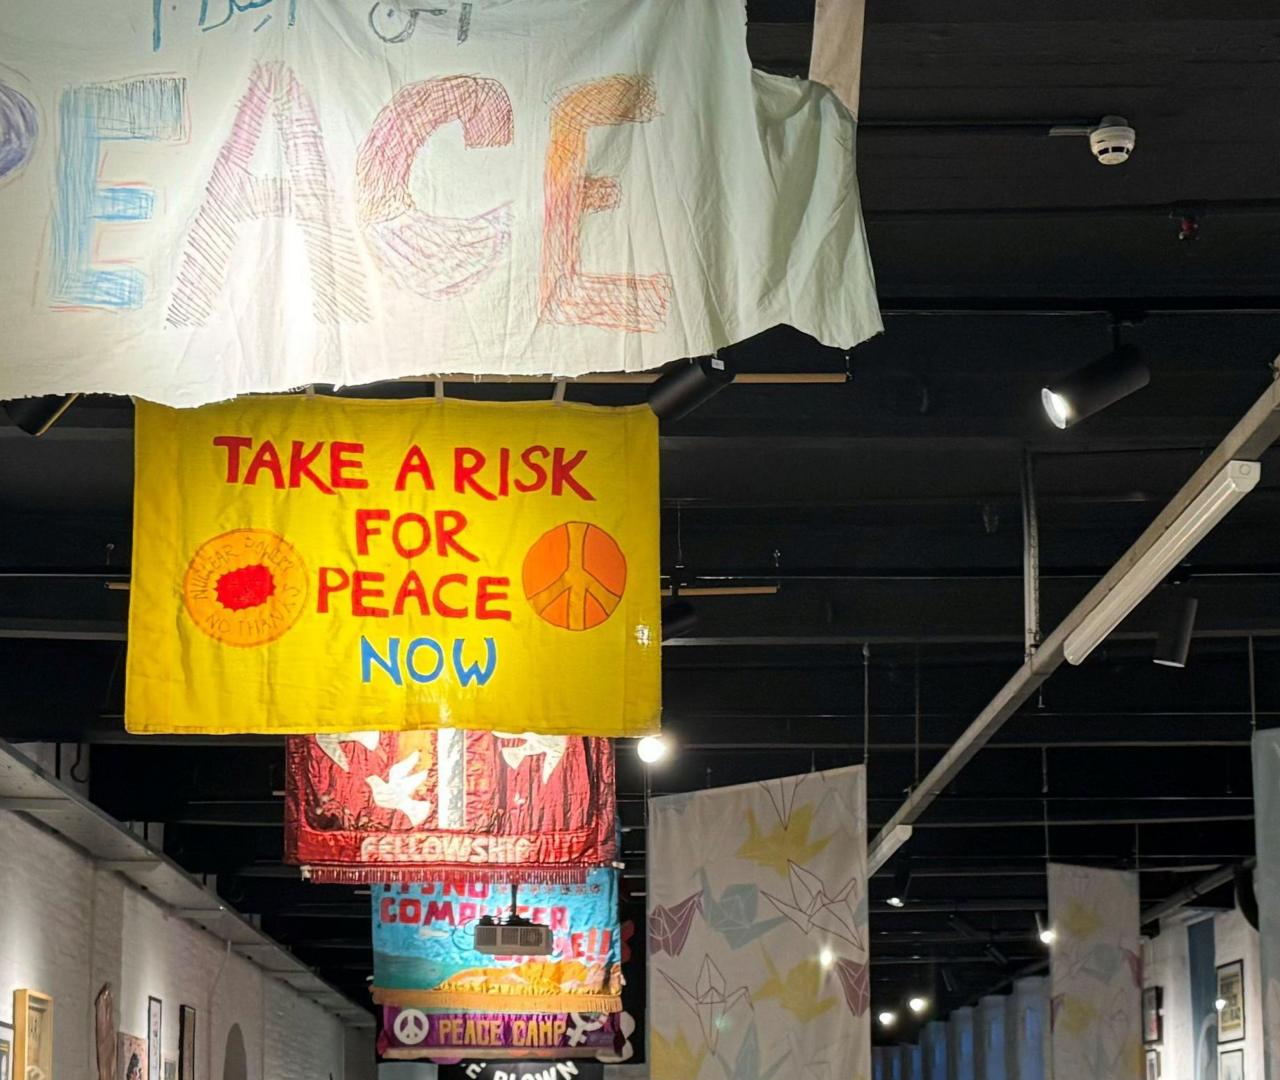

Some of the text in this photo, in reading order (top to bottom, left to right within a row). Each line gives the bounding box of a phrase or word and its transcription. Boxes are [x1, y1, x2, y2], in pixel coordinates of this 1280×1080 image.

[213, 436, 597, 501] TAKE A RISK
[355, 508, 480, 563] FOR
[316, 567, 512, 621] PEACE
[360, 635, 497, 689] NOW
[361, 833, 530, 864] FELLOWSHIP
[380, 897, 568, 931] COMPER
[439, 1017, 566, 1047] PEACE CAMP
